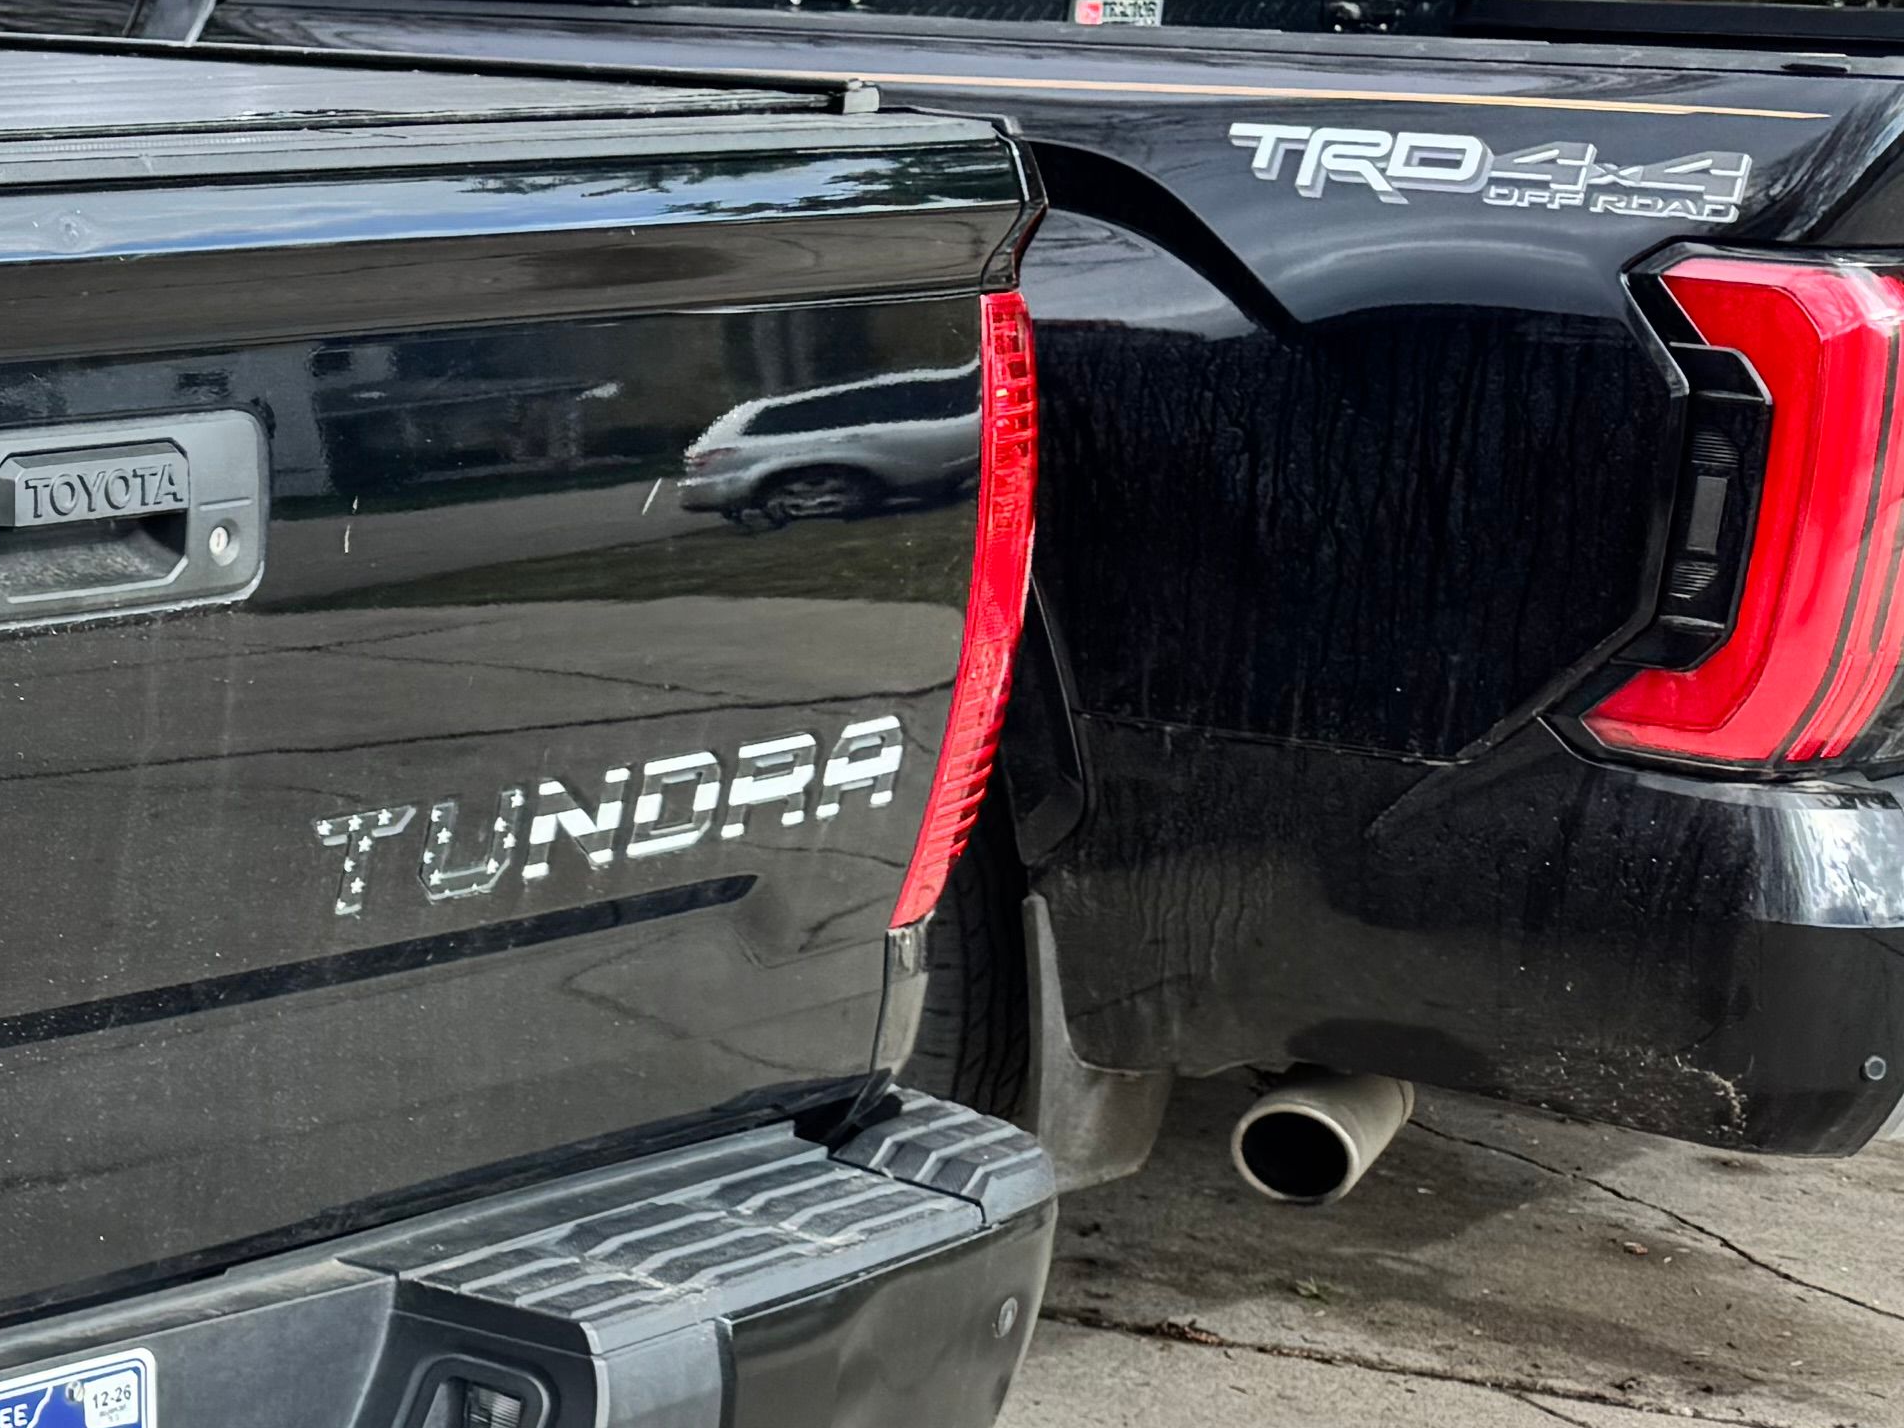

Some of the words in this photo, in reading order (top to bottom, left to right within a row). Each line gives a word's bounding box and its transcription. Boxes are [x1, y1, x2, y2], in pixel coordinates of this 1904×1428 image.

[1103, 0, 1157, 17] TRACTOR
[1229, 122, 1492, 205] TRD
[1482, 186, 1584, 210] OFF
[1589, 191, 1740, 224] ROAD
[24, 463, 184, 519] TOYOTA
[316, 715, 904, 917] TUNDRA
[92, 1384, 132, 1409] 12-26
